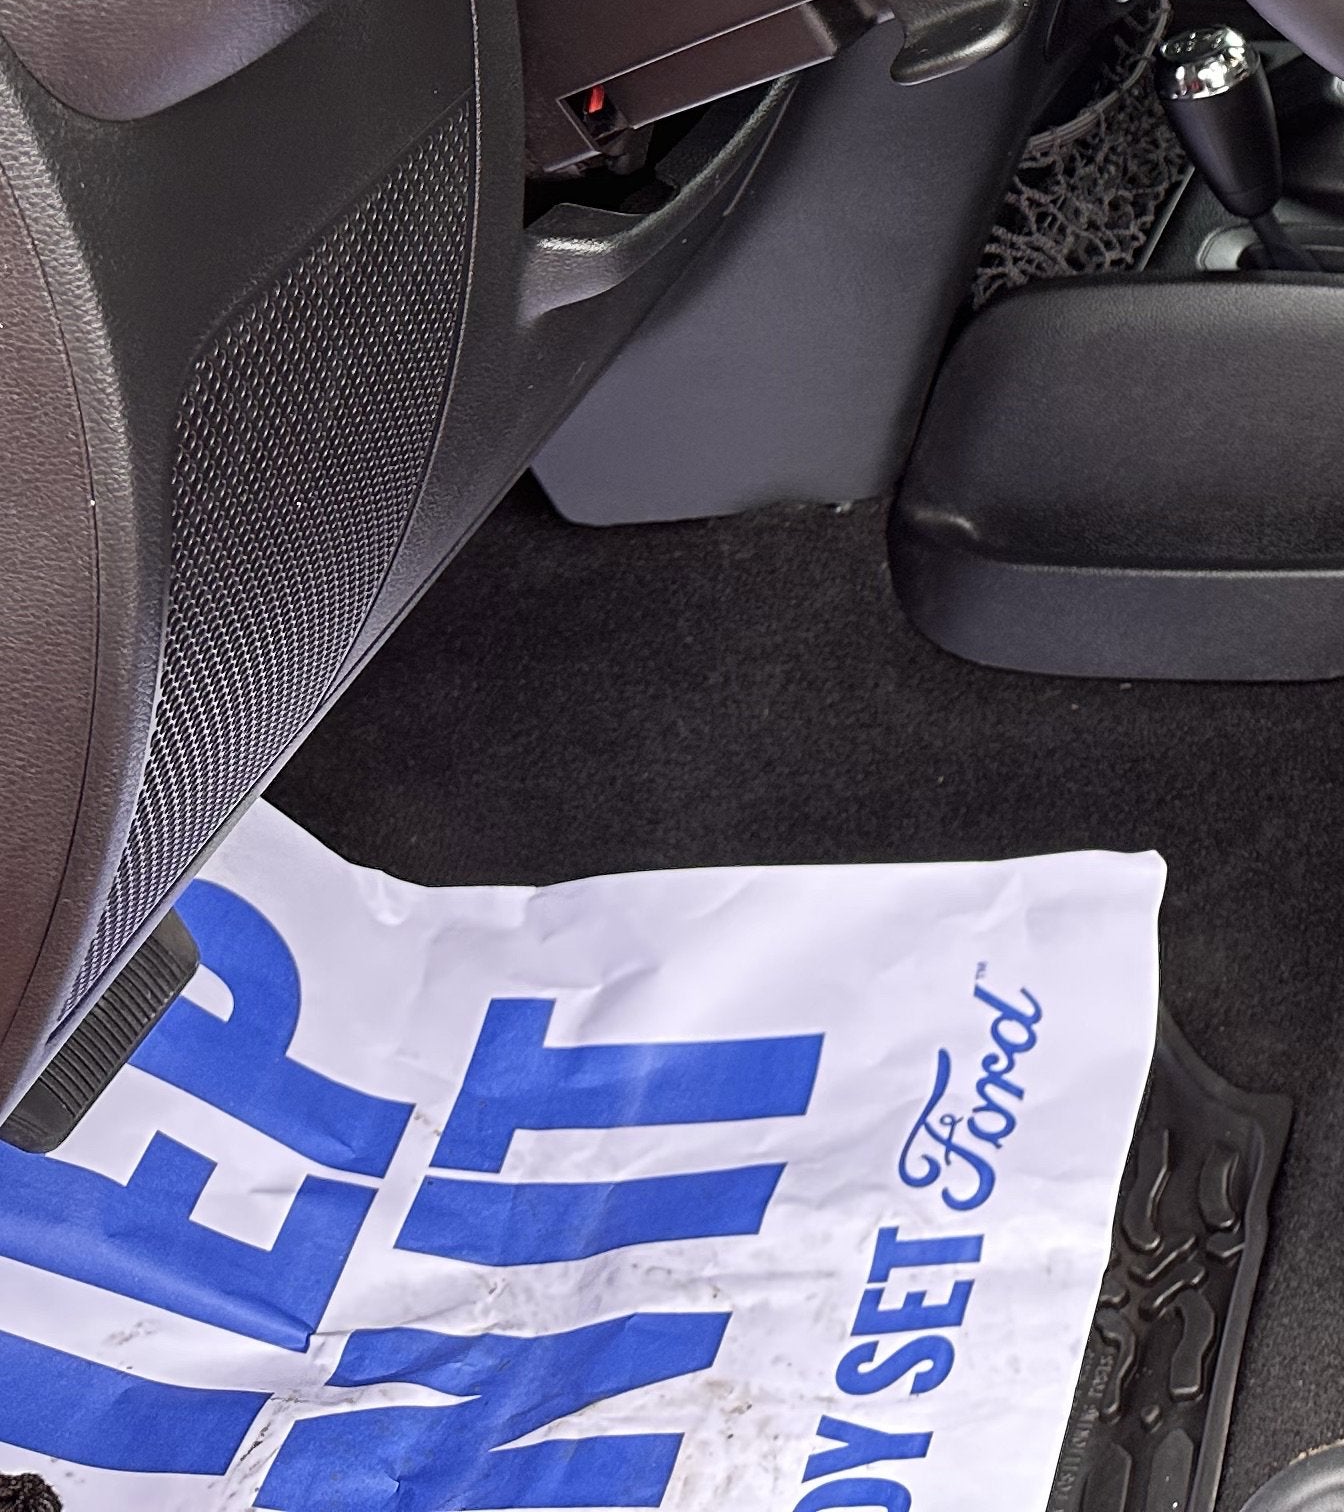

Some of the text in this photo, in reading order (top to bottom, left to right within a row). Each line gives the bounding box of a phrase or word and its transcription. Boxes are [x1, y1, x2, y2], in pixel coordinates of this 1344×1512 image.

[394, 997, 826, 1267] IT
[899, 983, 1043, 1211] Ford
[836, 1226, 984, 1396] SET
